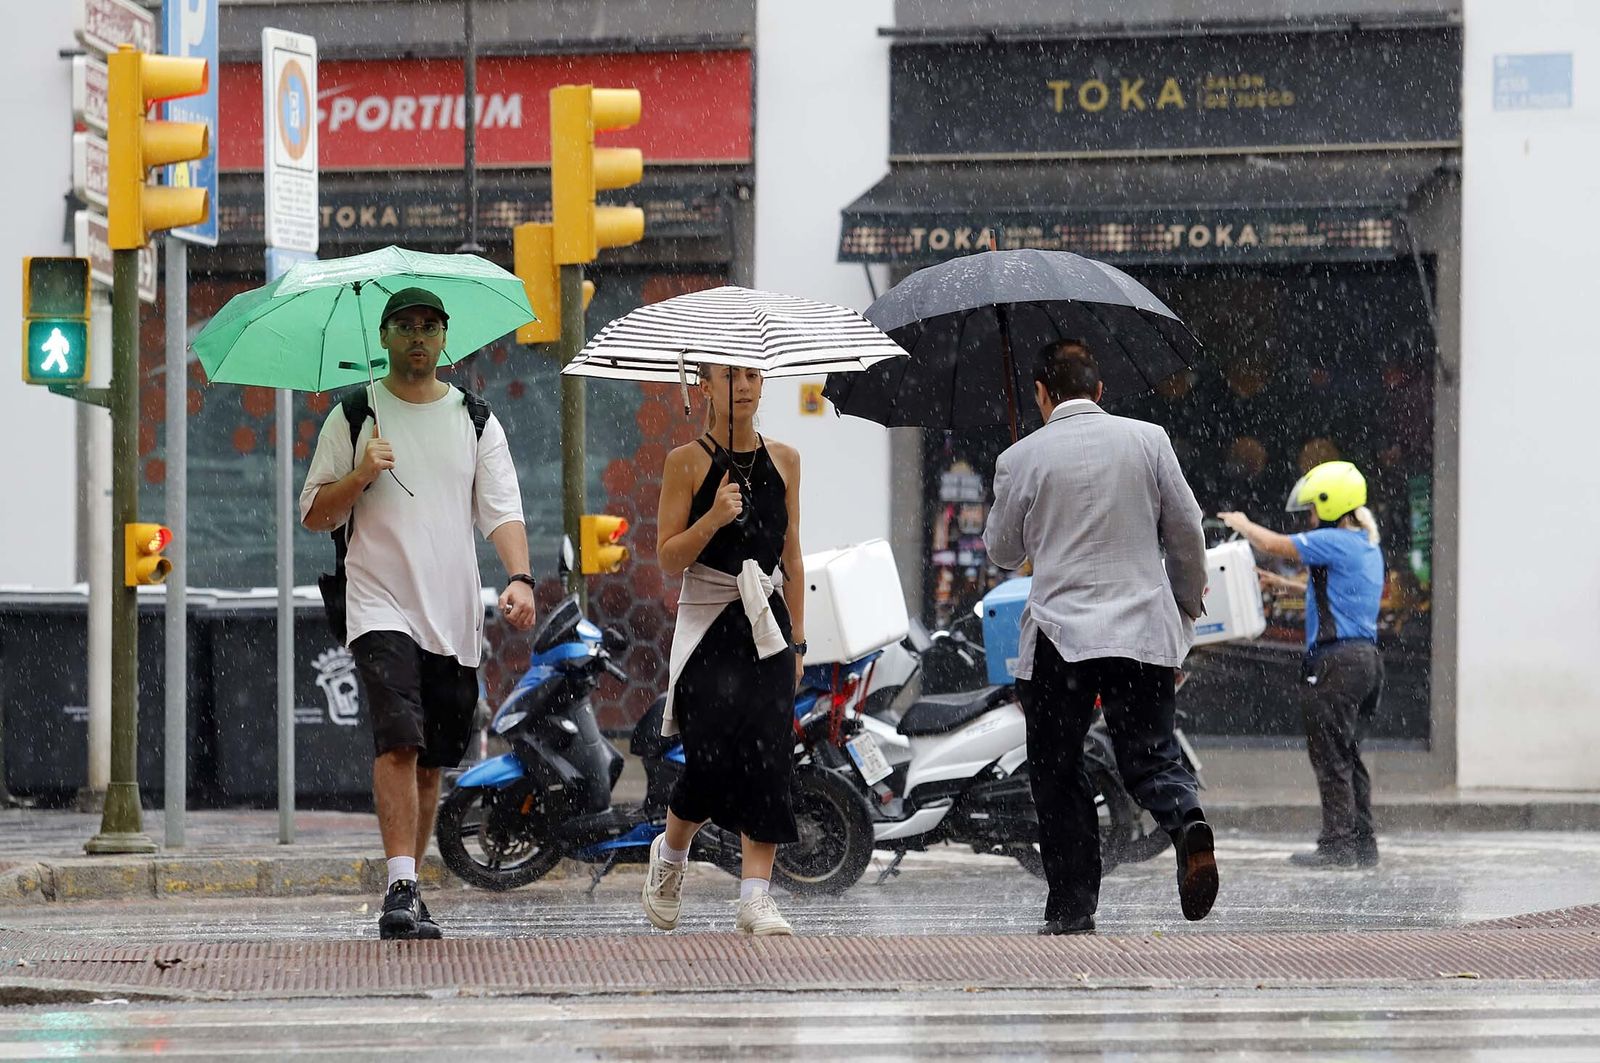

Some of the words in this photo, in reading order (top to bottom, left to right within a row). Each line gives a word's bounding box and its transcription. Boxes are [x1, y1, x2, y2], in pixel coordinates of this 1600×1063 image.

[1047, 77, 1186, 113] TOKA
[321, 205, 399, 229] TOKA
[911, 227, 995, 250] TOKA
[1169, 223, 1260, 248] TOKA
